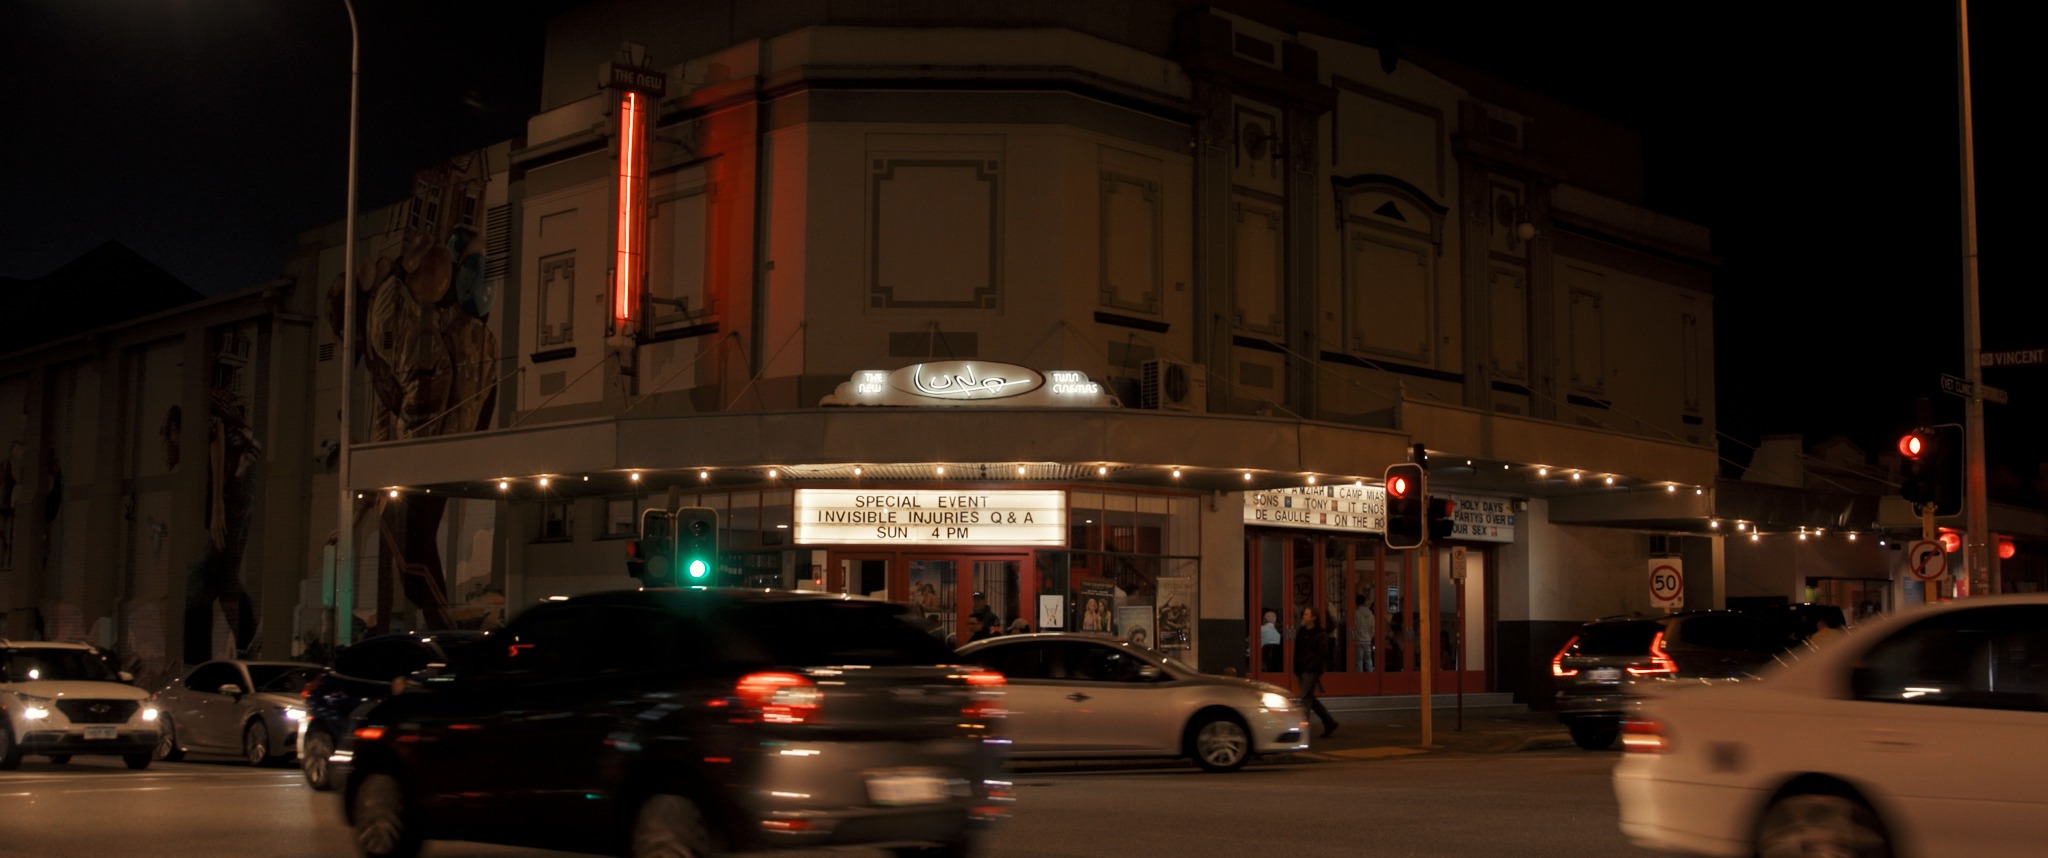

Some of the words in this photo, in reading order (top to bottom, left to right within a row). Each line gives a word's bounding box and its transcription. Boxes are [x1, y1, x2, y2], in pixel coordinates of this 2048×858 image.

[614, 69, 635, 84] THE
[637, 74, 662, 90] NEW
[1994, 349, 2044, 367] VINCENT
[864, 372, 883, 383] THE
[1053, 372, 1079, 383] TWIN
[1053, 384, 1098, 394] CINEMAS
[1339, 488, 1362, 500] CAMP
[856, 495, 921, 508] SPECIAL
[938, 495, 989, 508] EVENT
[1253, 494, 1279, 507] SONS
[1305, 497, 1328, 509] TONY
[1348, 502, 1356, 513] IT
[1362, 502, 1385, 515] ENDS
[1460, 500, 1479, 511] HOLY
[1483, 501, 1503, 513] DAYS
[818, 510, 898, 524] INVISIBLE
[908, 510, 980, 524] INJURIES
[990, 511, 1002, 524] Q
[1006, 511, 1018, 524] &
[1023, 511, 1034, 524] A
[1255, 509, 1267, 520] DE
[1275, 510, 1310, 523] GAULLE
[1335, 514, 1348, 526] ON
[1353, 516, 1368, 528] THE
[1454, 511, 1483, 523] PARTYS
[1486, 514, 1506, 525] OVER
[876, 526, 908, 539] SUN
[931, 526, 940, 539] 4
[947, 526, 969, 539] PM
[1472, 525, 1487, 535] SEX
[1655, 574, 1676, 591] 50
